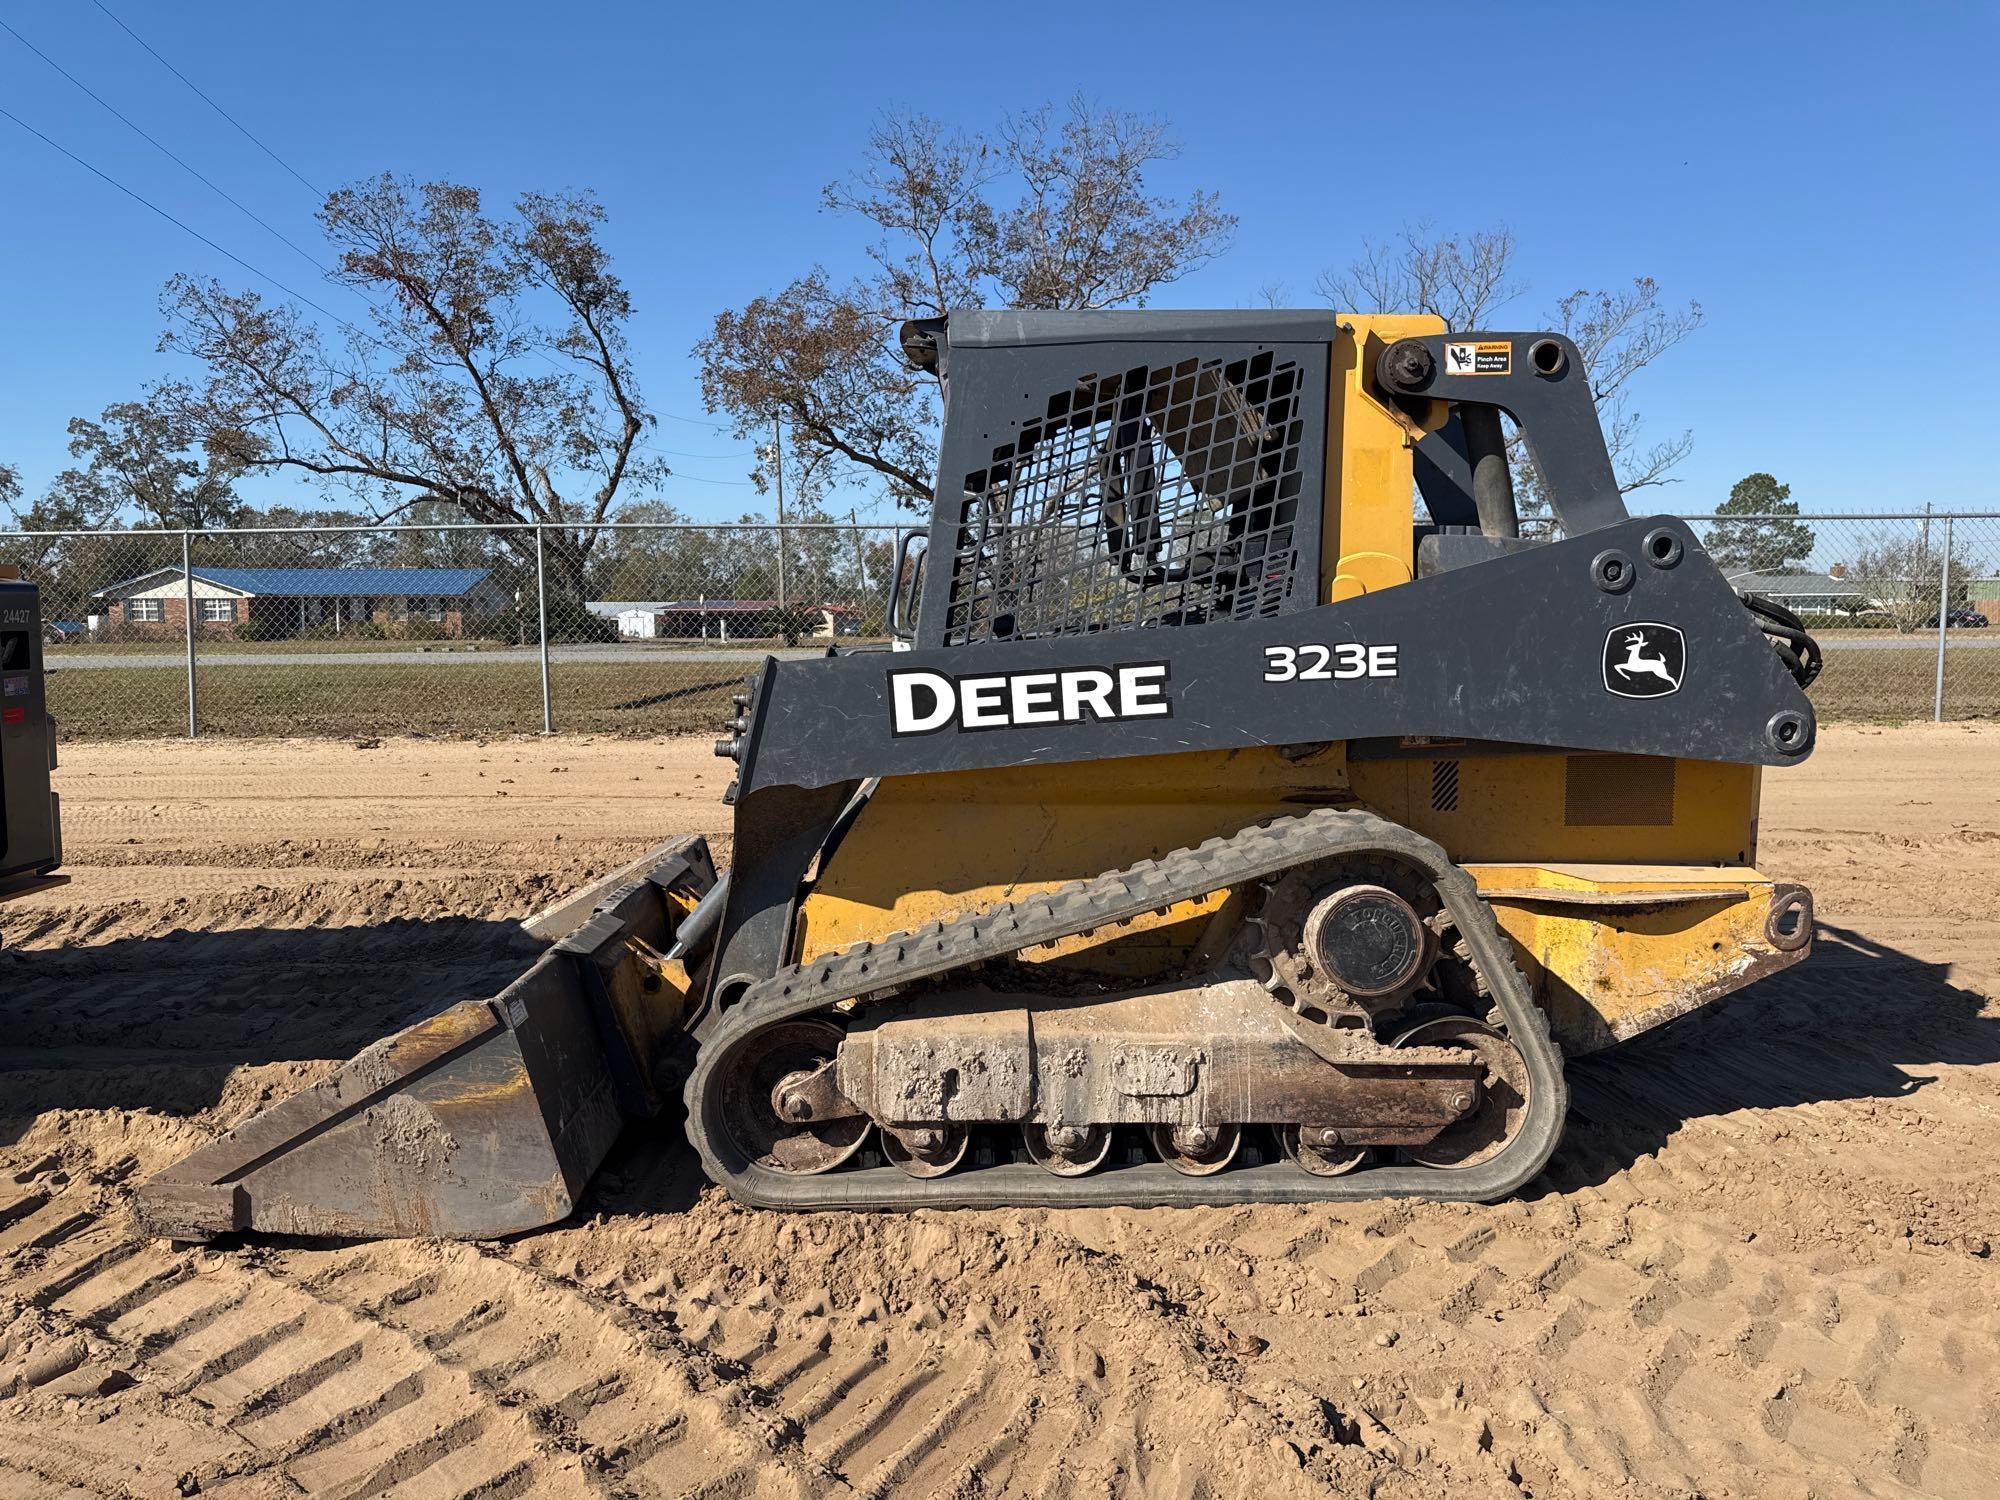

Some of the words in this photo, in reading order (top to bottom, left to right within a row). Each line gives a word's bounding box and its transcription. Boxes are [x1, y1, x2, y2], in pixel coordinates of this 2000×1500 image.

[3, 609, 30, 624] 24427
[1264, 643, 1398, 682] 323E
[891, 665, 1169, 733] DEERE
